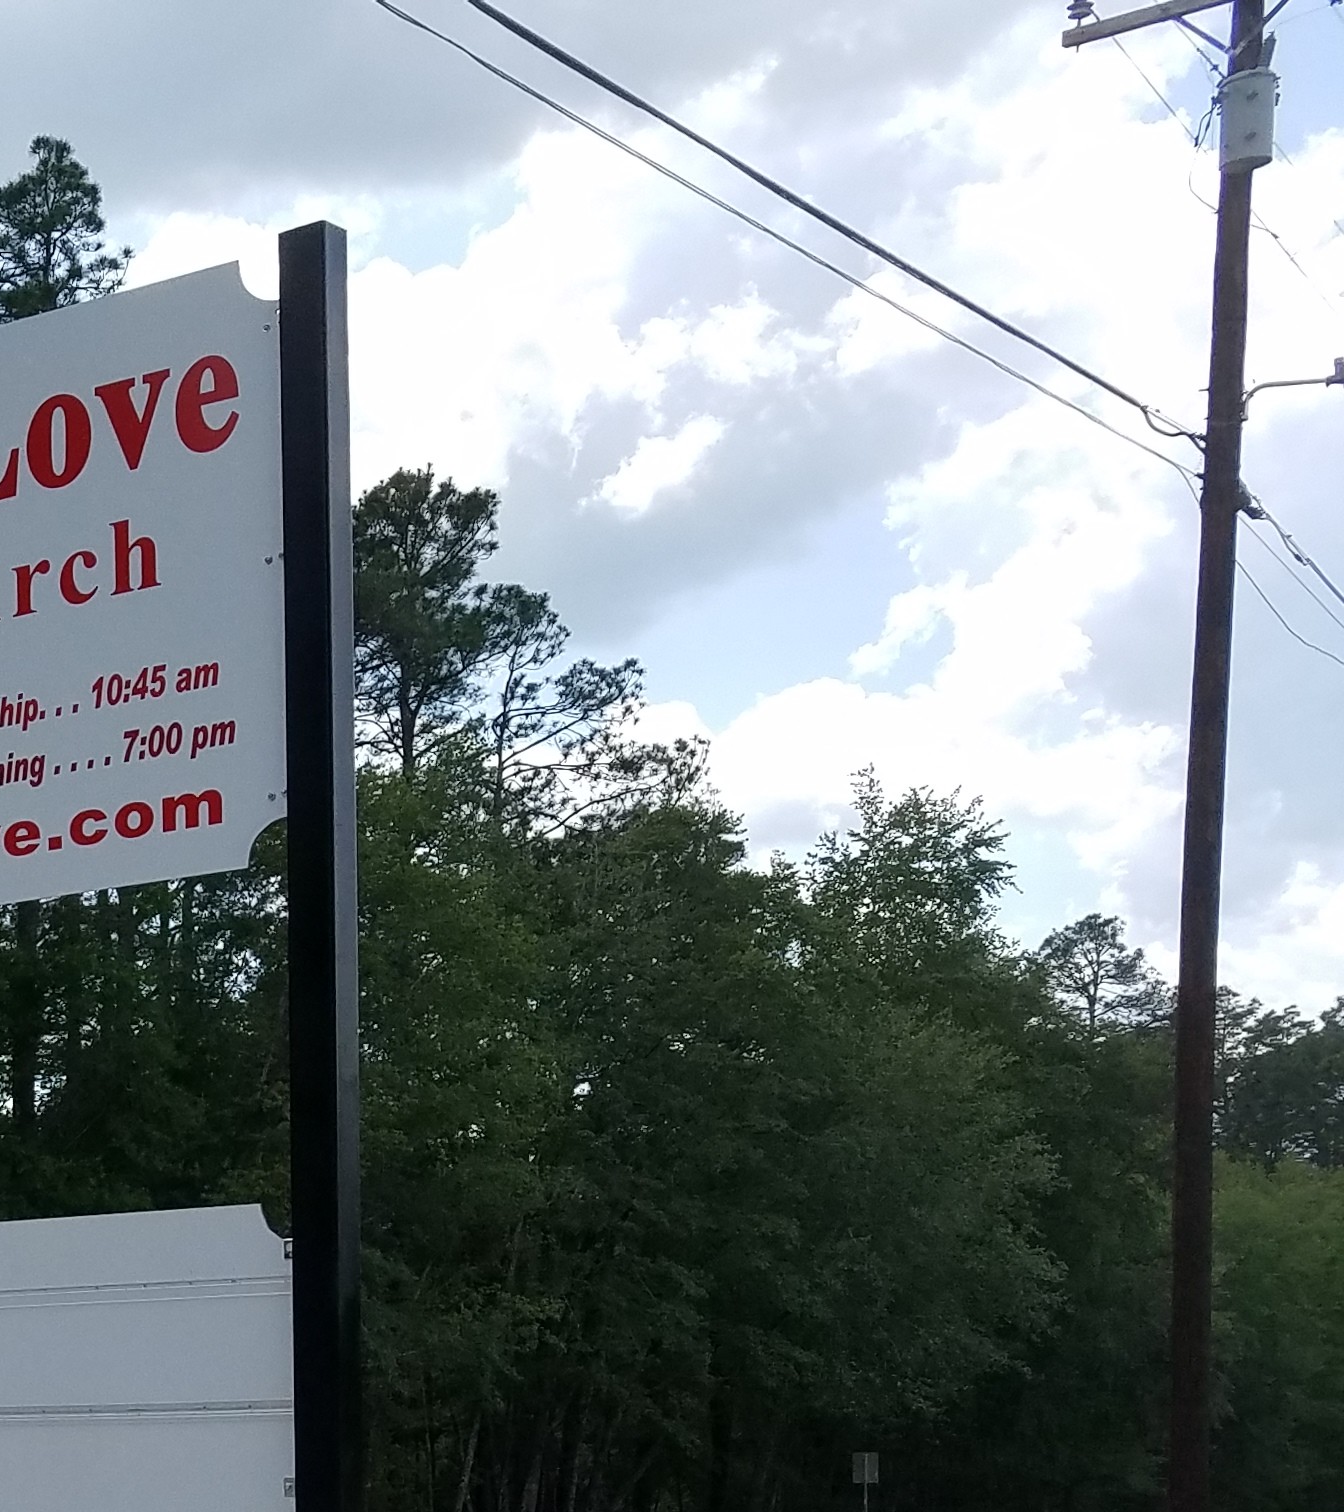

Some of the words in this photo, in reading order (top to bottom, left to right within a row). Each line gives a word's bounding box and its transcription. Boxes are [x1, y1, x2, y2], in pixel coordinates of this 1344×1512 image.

[91, 663, 167, 709] 10:45
[175, 662, 219, 693] am
[123, 721, 183, 763] 7:00
[189, 720, 236, 760] pm
